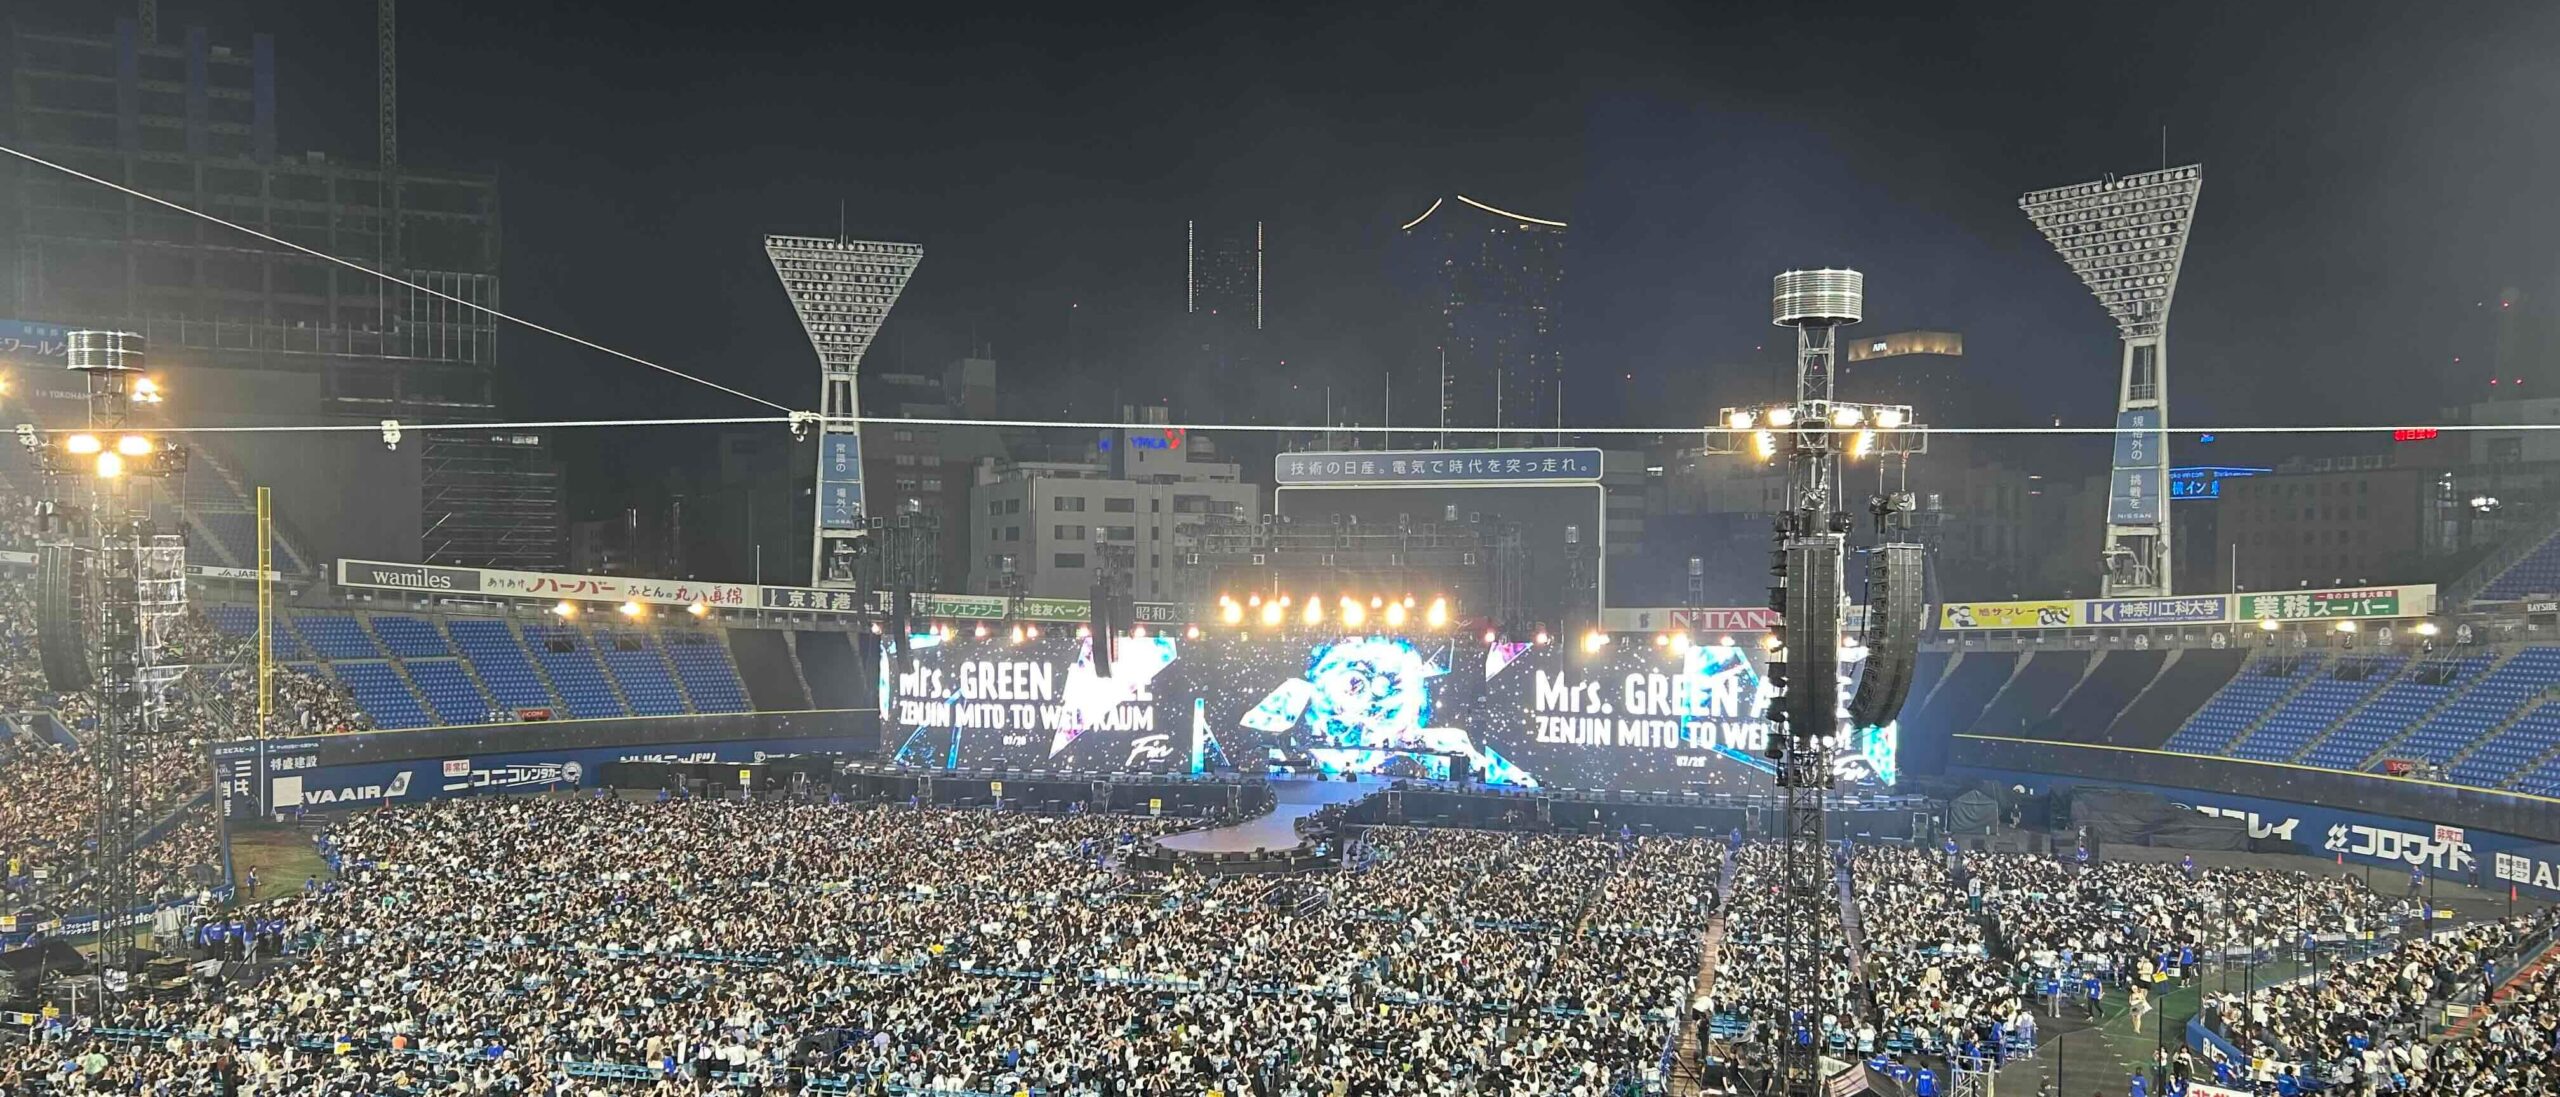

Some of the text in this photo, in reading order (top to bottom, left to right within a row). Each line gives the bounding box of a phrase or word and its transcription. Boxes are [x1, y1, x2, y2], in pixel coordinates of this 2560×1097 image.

[1291, 458, 1588, 475] 技術の日産。電気で時代を突っ走れ。
[372, 568, 451, 588] wamiles
[487, 577, 616, 595] ありあけ ハーバー
[2119, 600, 2218, 618] 神奈川工科大学
[959, 661, 1053, 701] GREEN
[1535, 669, 1613, 715] Mrs.
[1625, 672, 1738, 718] GREEN
[900, 700, 951, 728] ZENJIN
[955, 702, 1005, 730] MITO
[1010, 703, 1035, 730] TO
[1535, 716, 1611, 746] ZENJIN
[1618, 719, 1680, 749] MITO
[1687, 721, 1717, 750] TO
[444, 761, 469, 773] 非常口
[339, 785, 381, 802] AIR
[2436, 827, 2464, 843] 非常口
